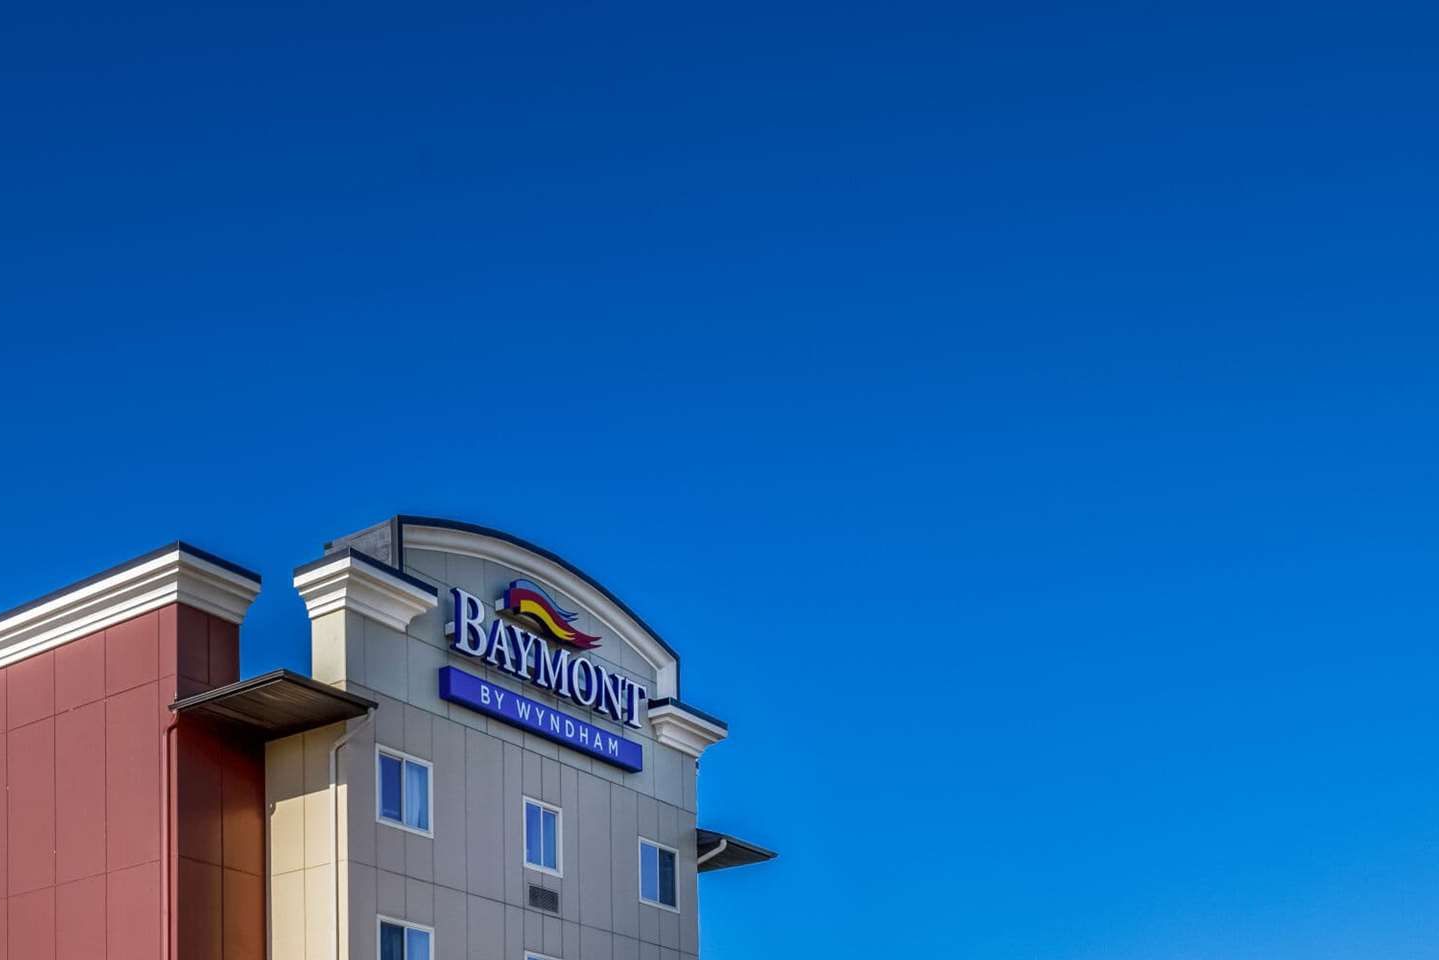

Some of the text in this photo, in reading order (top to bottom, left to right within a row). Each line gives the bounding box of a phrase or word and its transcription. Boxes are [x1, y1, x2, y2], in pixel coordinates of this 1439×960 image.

[450, 587, 647, 729] BAYMONT
[480, 685, 619, 757] BY WYNDHAM
